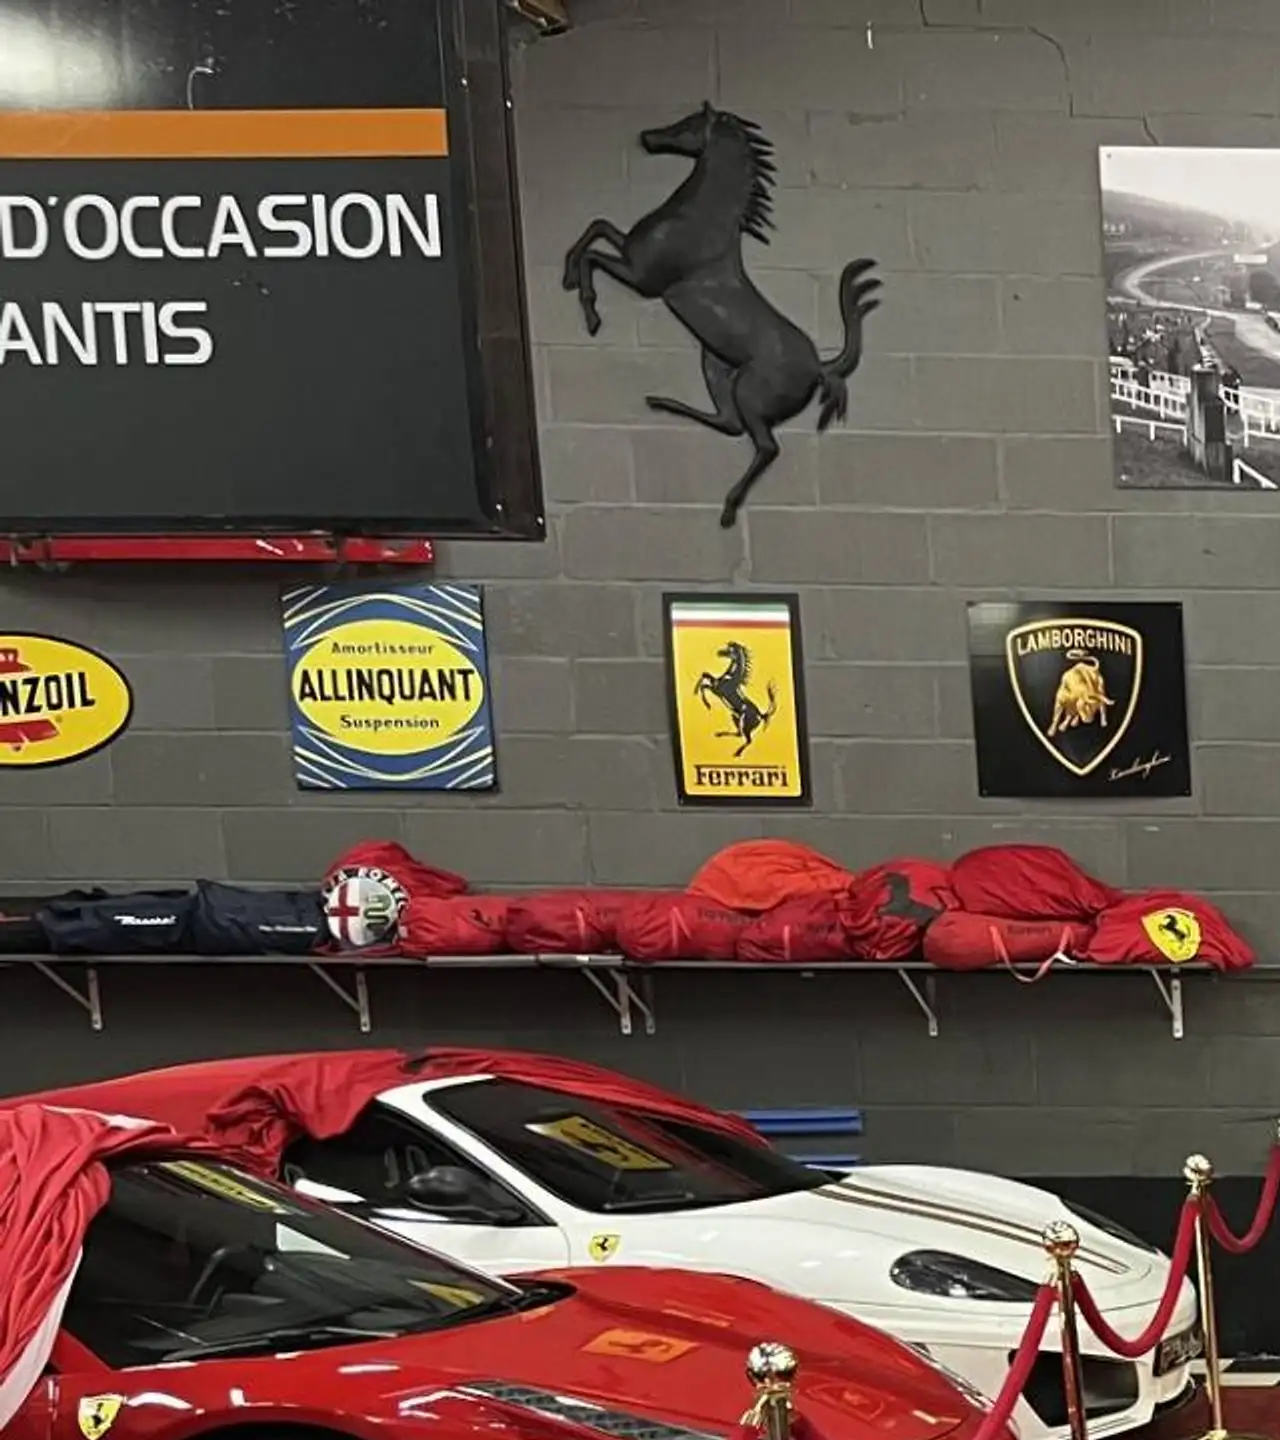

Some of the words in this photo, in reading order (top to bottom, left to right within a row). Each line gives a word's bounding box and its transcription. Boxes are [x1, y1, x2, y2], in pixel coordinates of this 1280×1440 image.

[1, 193, 442, 259] D'OCCASION
[331, 641, 435, 655] Amortisseur
[1016, 627, 1132, 657] LAMBORGHINI
[299, 668, 475, 705] ALLINQUANT
[339, 714, 440, 732] Suspension
[694, 763, 788, 788] Ferrari
